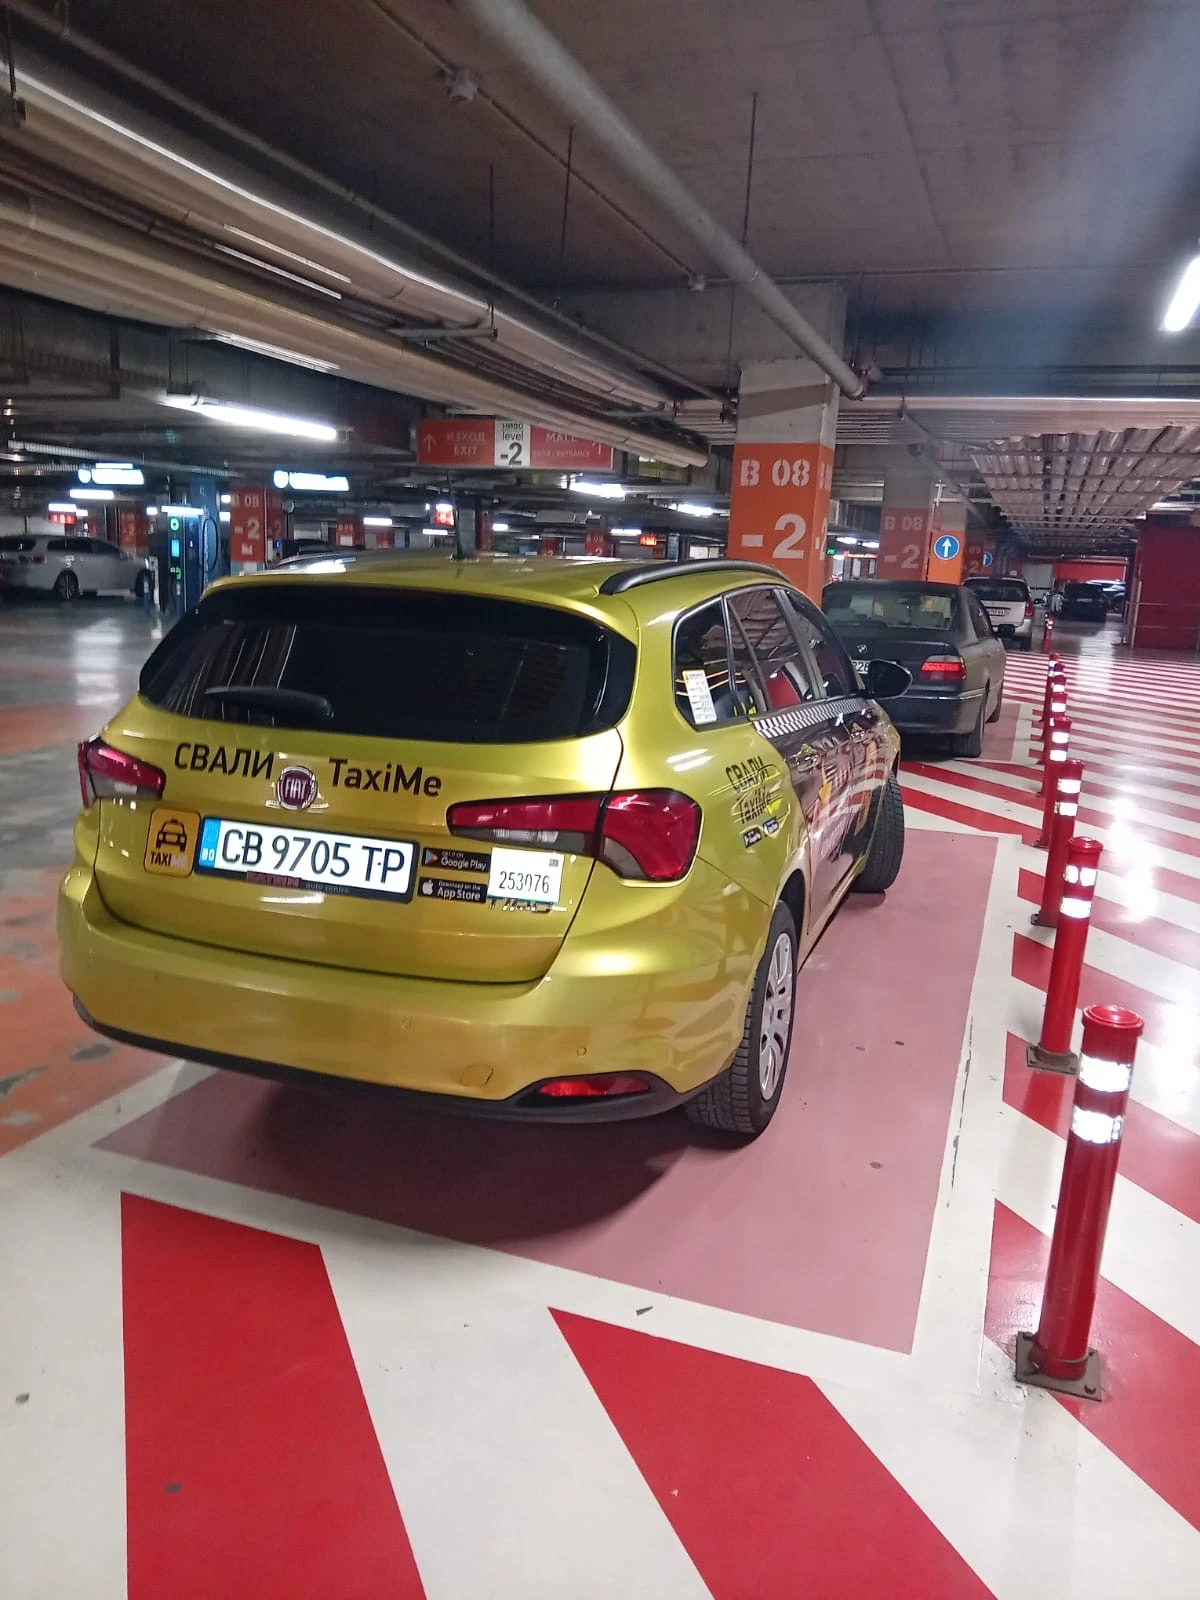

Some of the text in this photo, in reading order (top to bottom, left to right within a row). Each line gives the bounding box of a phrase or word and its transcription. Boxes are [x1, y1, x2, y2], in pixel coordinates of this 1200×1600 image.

[502, 430, 524, 441] level
[501, 442, 522, 465] -2
[740, 459, 760, 487] B
[772, 459, 810, 487] 08
[902, 516, 923, 530] 08
[174, 742, 275, 780] СВАЛИ
[284, 777, 309, 800] FIAT
[329, 758, 442, 797] TaxiMe
[221, 829, 405, 884] CB 9705 TP
[441, 856, 487, 872] Google Play
[437, 886, 481, 901] App Store
[498, 870, 550, 894] 253076
